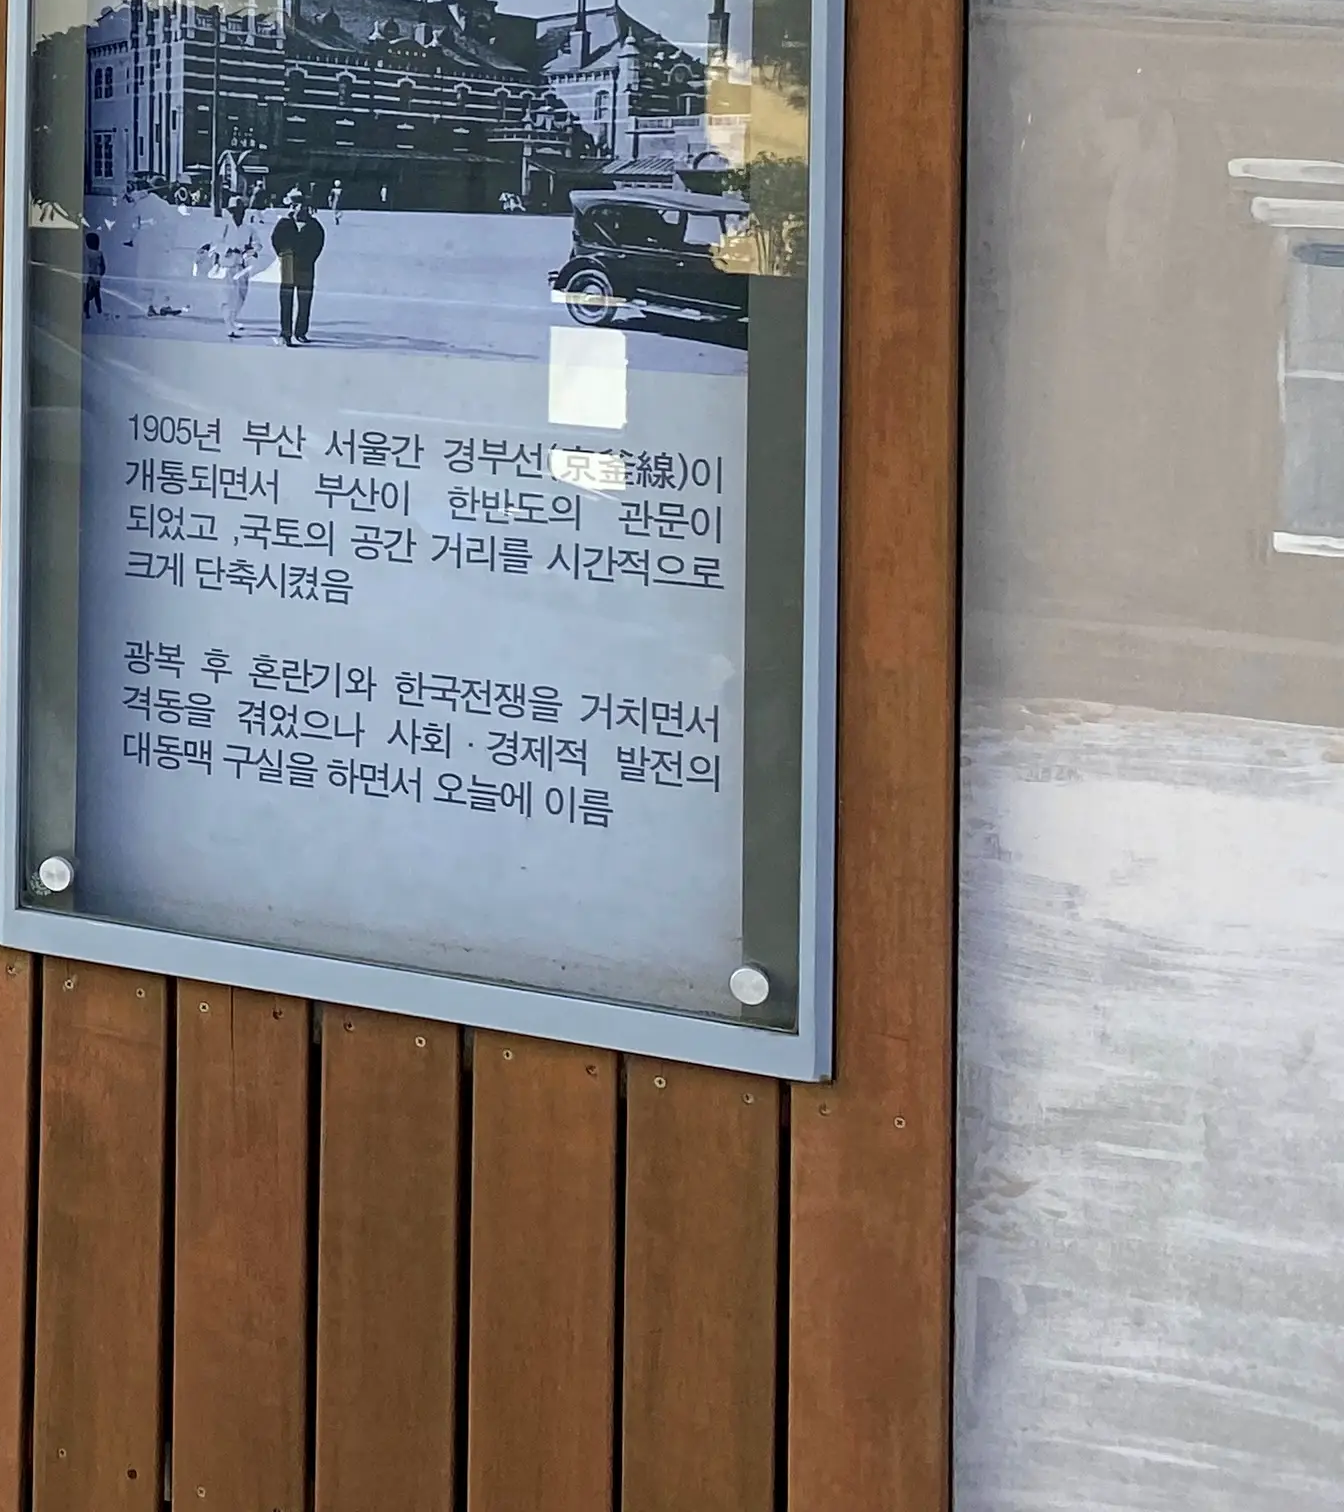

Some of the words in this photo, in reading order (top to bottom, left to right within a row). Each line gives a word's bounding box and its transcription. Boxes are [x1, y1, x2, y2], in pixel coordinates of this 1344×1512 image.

[128, 413, 221, 453] 1905년
[242, 420, 306, 460] 부산
[324, 428, 424, 469] 서울간
[125, 458, 279, 504] 개통되면서
[314, 472, 409, 516] 부산이
[447, 485, 581, 531] 한반도의
[618, 499, 722, 544] 관문이
[125, 551, 184, 587] 크게
[195, 555, 354, 605] 단축시켰음
[126, 503, 218, 541] 되었고
[350, 523, 417, 564] 공간
[431, 531, 533, 575] 거리를
[546, 542, 725, 590] 시간적으로
[124, 640, 185, 679] 광복
[201, 648, 232, 684] 후
[248, 653, 377, 702] 혼란기와
[395, 670, 563, 724] 한국전쟁을
[580, 691, 720, 743] 거치면서
[122, 686, 215, 729] 격동을
[237, 700, 365, 748] 겪었으나
[387, 718, 451, 759] 사회
[486, 729, 587, 776] 경제적
[616, 745, 720, 793] 발전의
[123, 731, 213, 776] 대동맥
[223, 743, 318, 789] 구실을
[327, 758, 422, 804] 하면서
[433, 772, 532, 819] 오늘에
[545, 786, 614, 828] 이름
